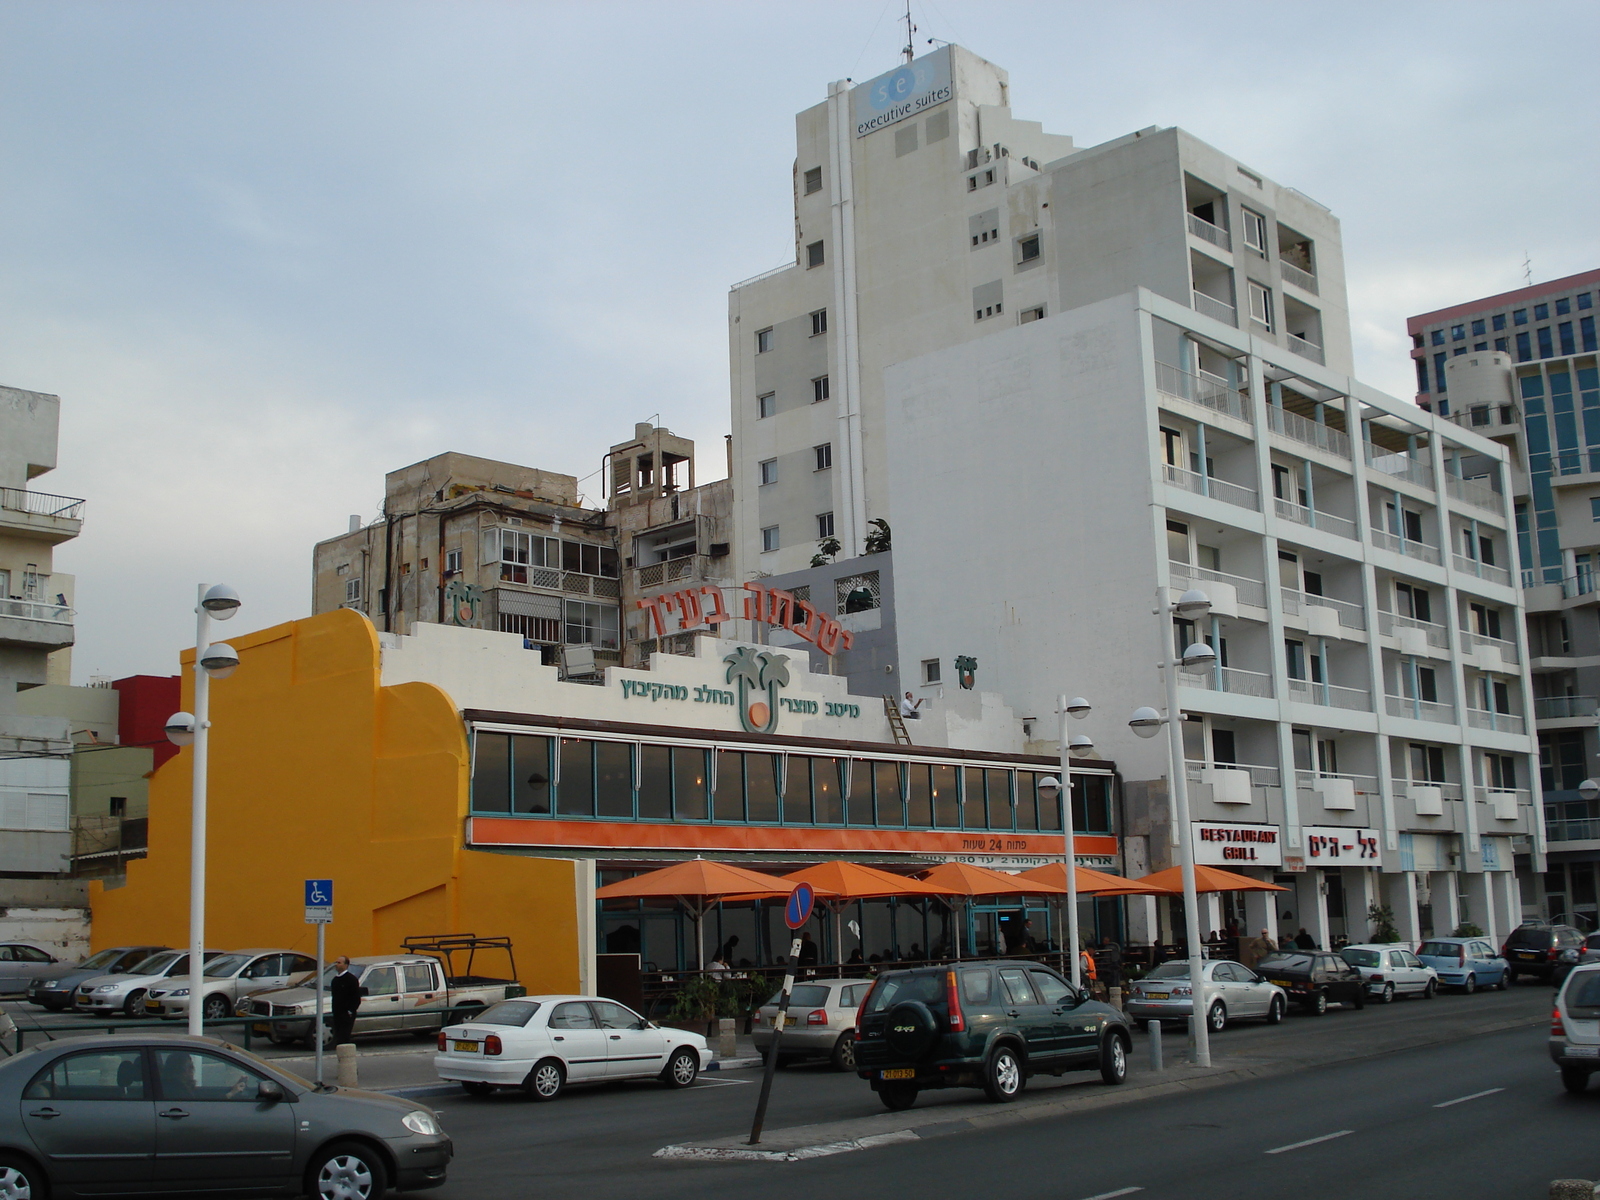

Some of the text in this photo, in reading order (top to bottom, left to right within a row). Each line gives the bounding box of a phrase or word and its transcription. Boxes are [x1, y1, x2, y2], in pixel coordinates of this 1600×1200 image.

[857, 86, 950, 134] executive suites
[636, 581, 855, 656] יטבתה בעיר
[620, 679, 861, 719] מיטב מוצרי החלב מהקיבוץ
[1200, 828, 1278, 844] RESTAURANT
[962, 839, 1027, 851] פתוח 24 שעות
[978, 856, 994, 864] עד
[1001, 856, 1009, 864] 2
[1011, 857, 1049, 865] בקומה
[1222, 846, 1259, 861] GRILL
